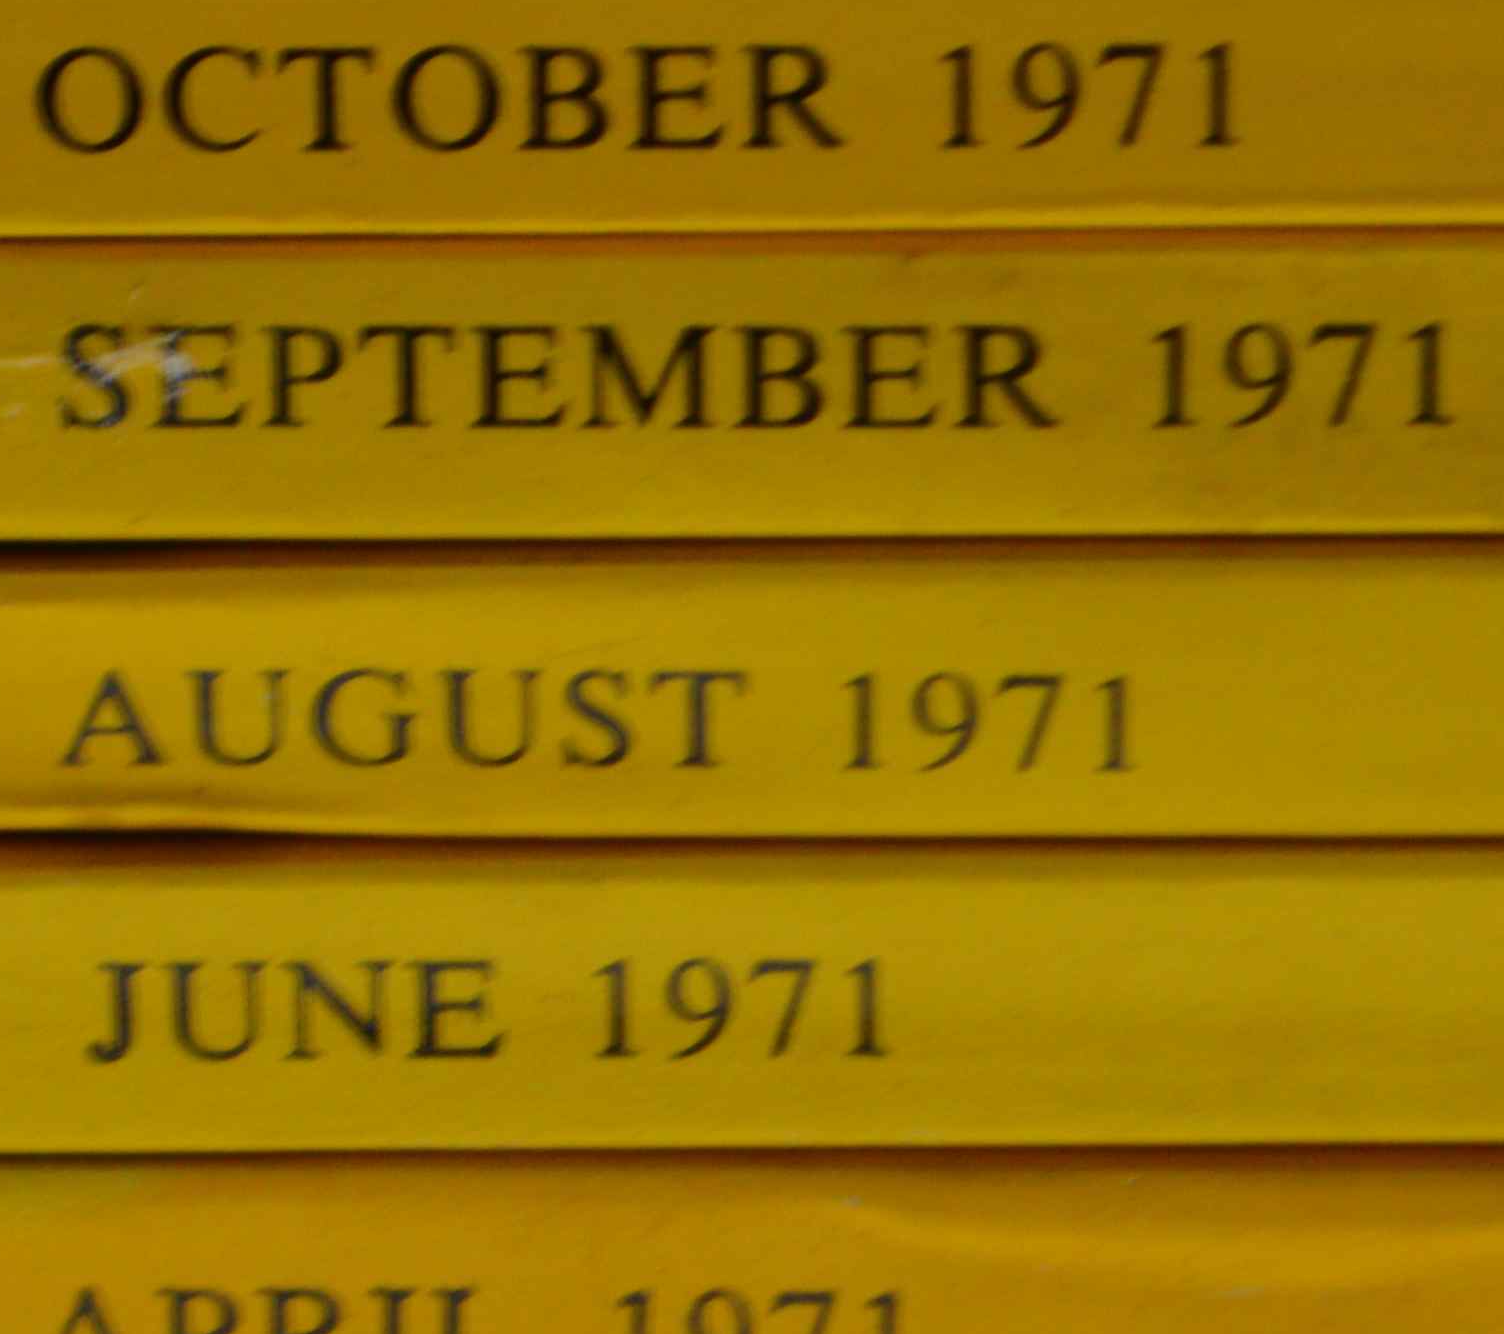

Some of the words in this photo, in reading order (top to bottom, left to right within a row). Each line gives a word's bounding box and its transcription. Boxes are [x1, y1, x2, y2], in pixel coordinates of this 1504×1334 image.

[32, 43, 846, 156] OCTOBER
[939, 41, 1239, 151] 1971
[60, 322, 1062, 431] SEPTEMBER
[1151, 321, 1455, 430] 1971
[60, 668, 748, 770] AUGUST
[843, 671, 1130, 773] 1971
[84, 959, 506, 1066] JUNE
[595, 958, 889, 1061] 1971
